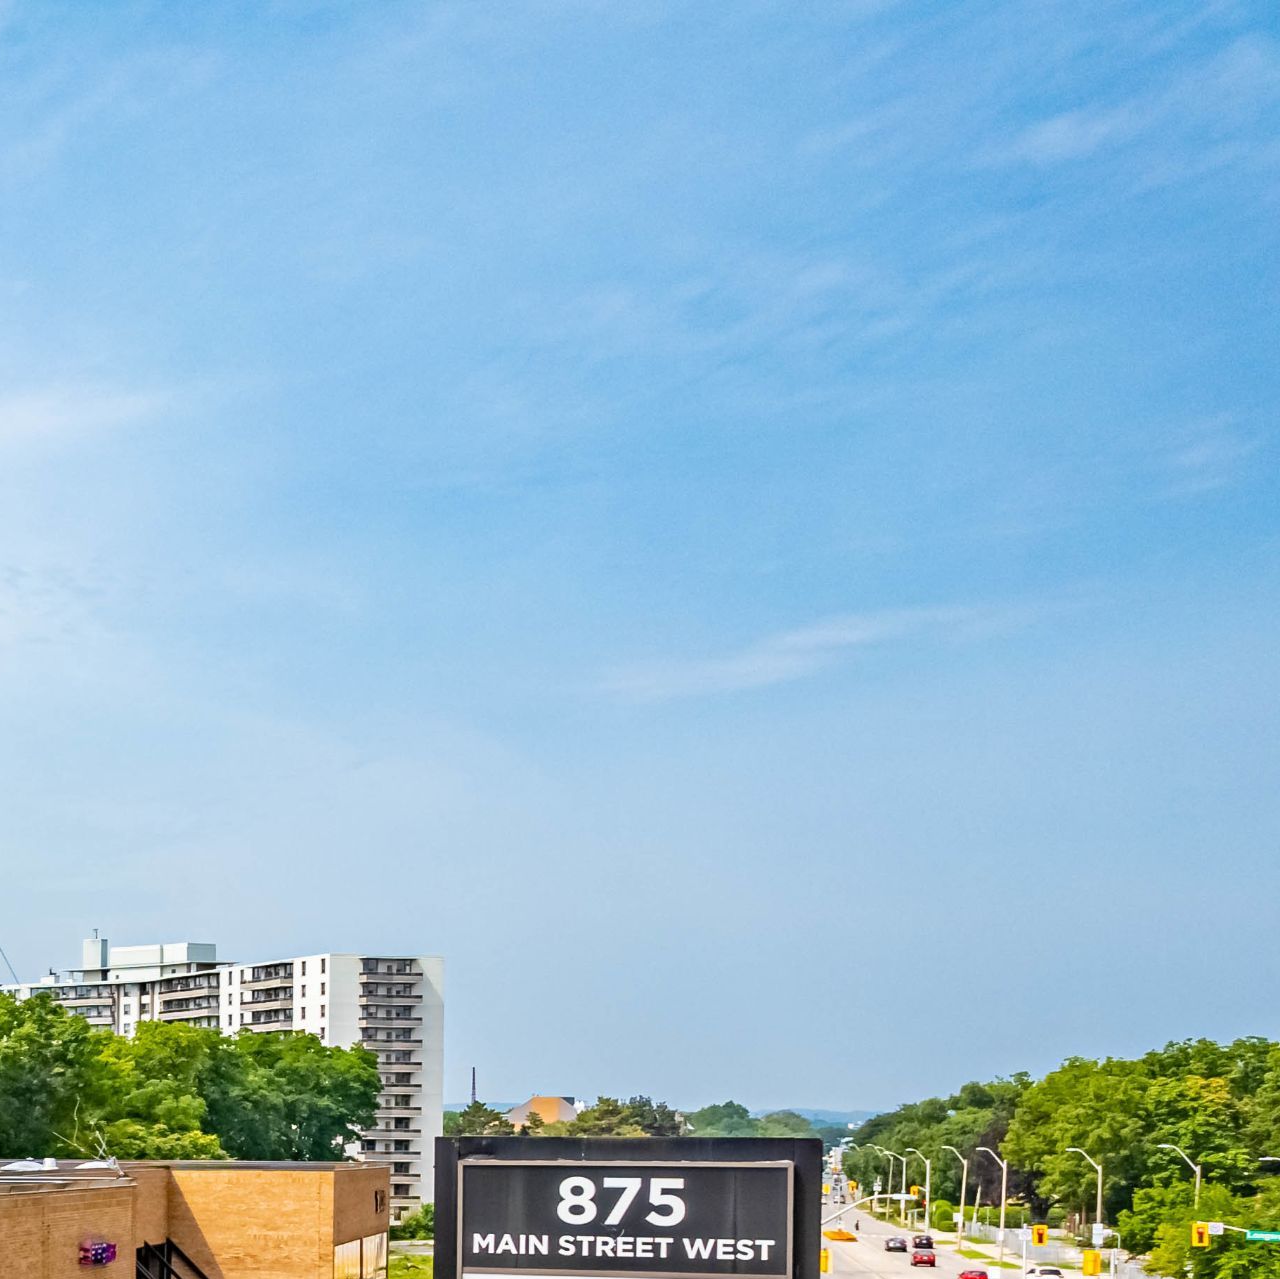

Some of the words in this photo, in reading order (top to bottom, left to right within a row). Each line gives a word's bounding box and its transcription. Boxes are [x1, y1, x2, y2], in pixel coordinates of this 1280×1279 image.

[556, 1176, 686, 1227] 875
[472, 1233, 549, 1255] MAIN
[558, 1235, 674, 1258] STREET
[682, 1238, 776, 1261] WEST
